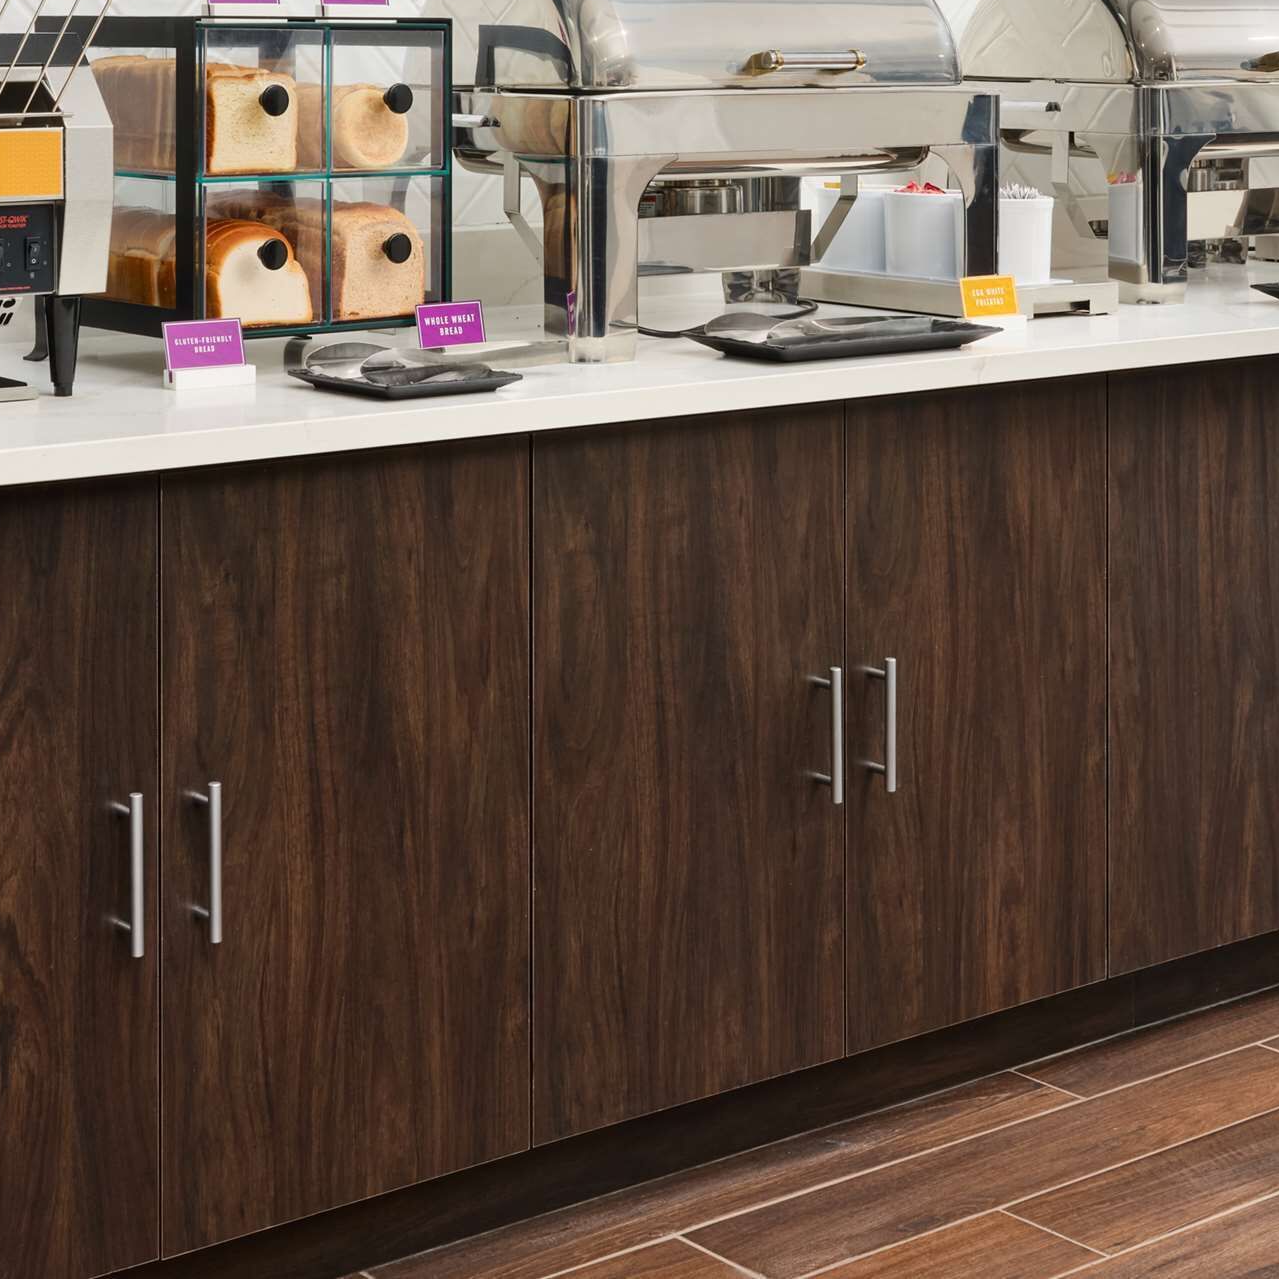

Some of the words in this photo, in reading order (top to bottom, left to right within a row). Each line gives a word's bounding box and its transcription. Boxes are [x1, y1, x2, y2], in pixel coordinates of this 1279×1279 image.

[424, 315, 449, 326] WHOLE
[451, 313, 475, 324] WHEAT
[439, 326, 464, 336] BREAD
[174, 335, 233, 346] GLUTEN-FRIENDLY
[194, 345, 215, 353] BREAD
